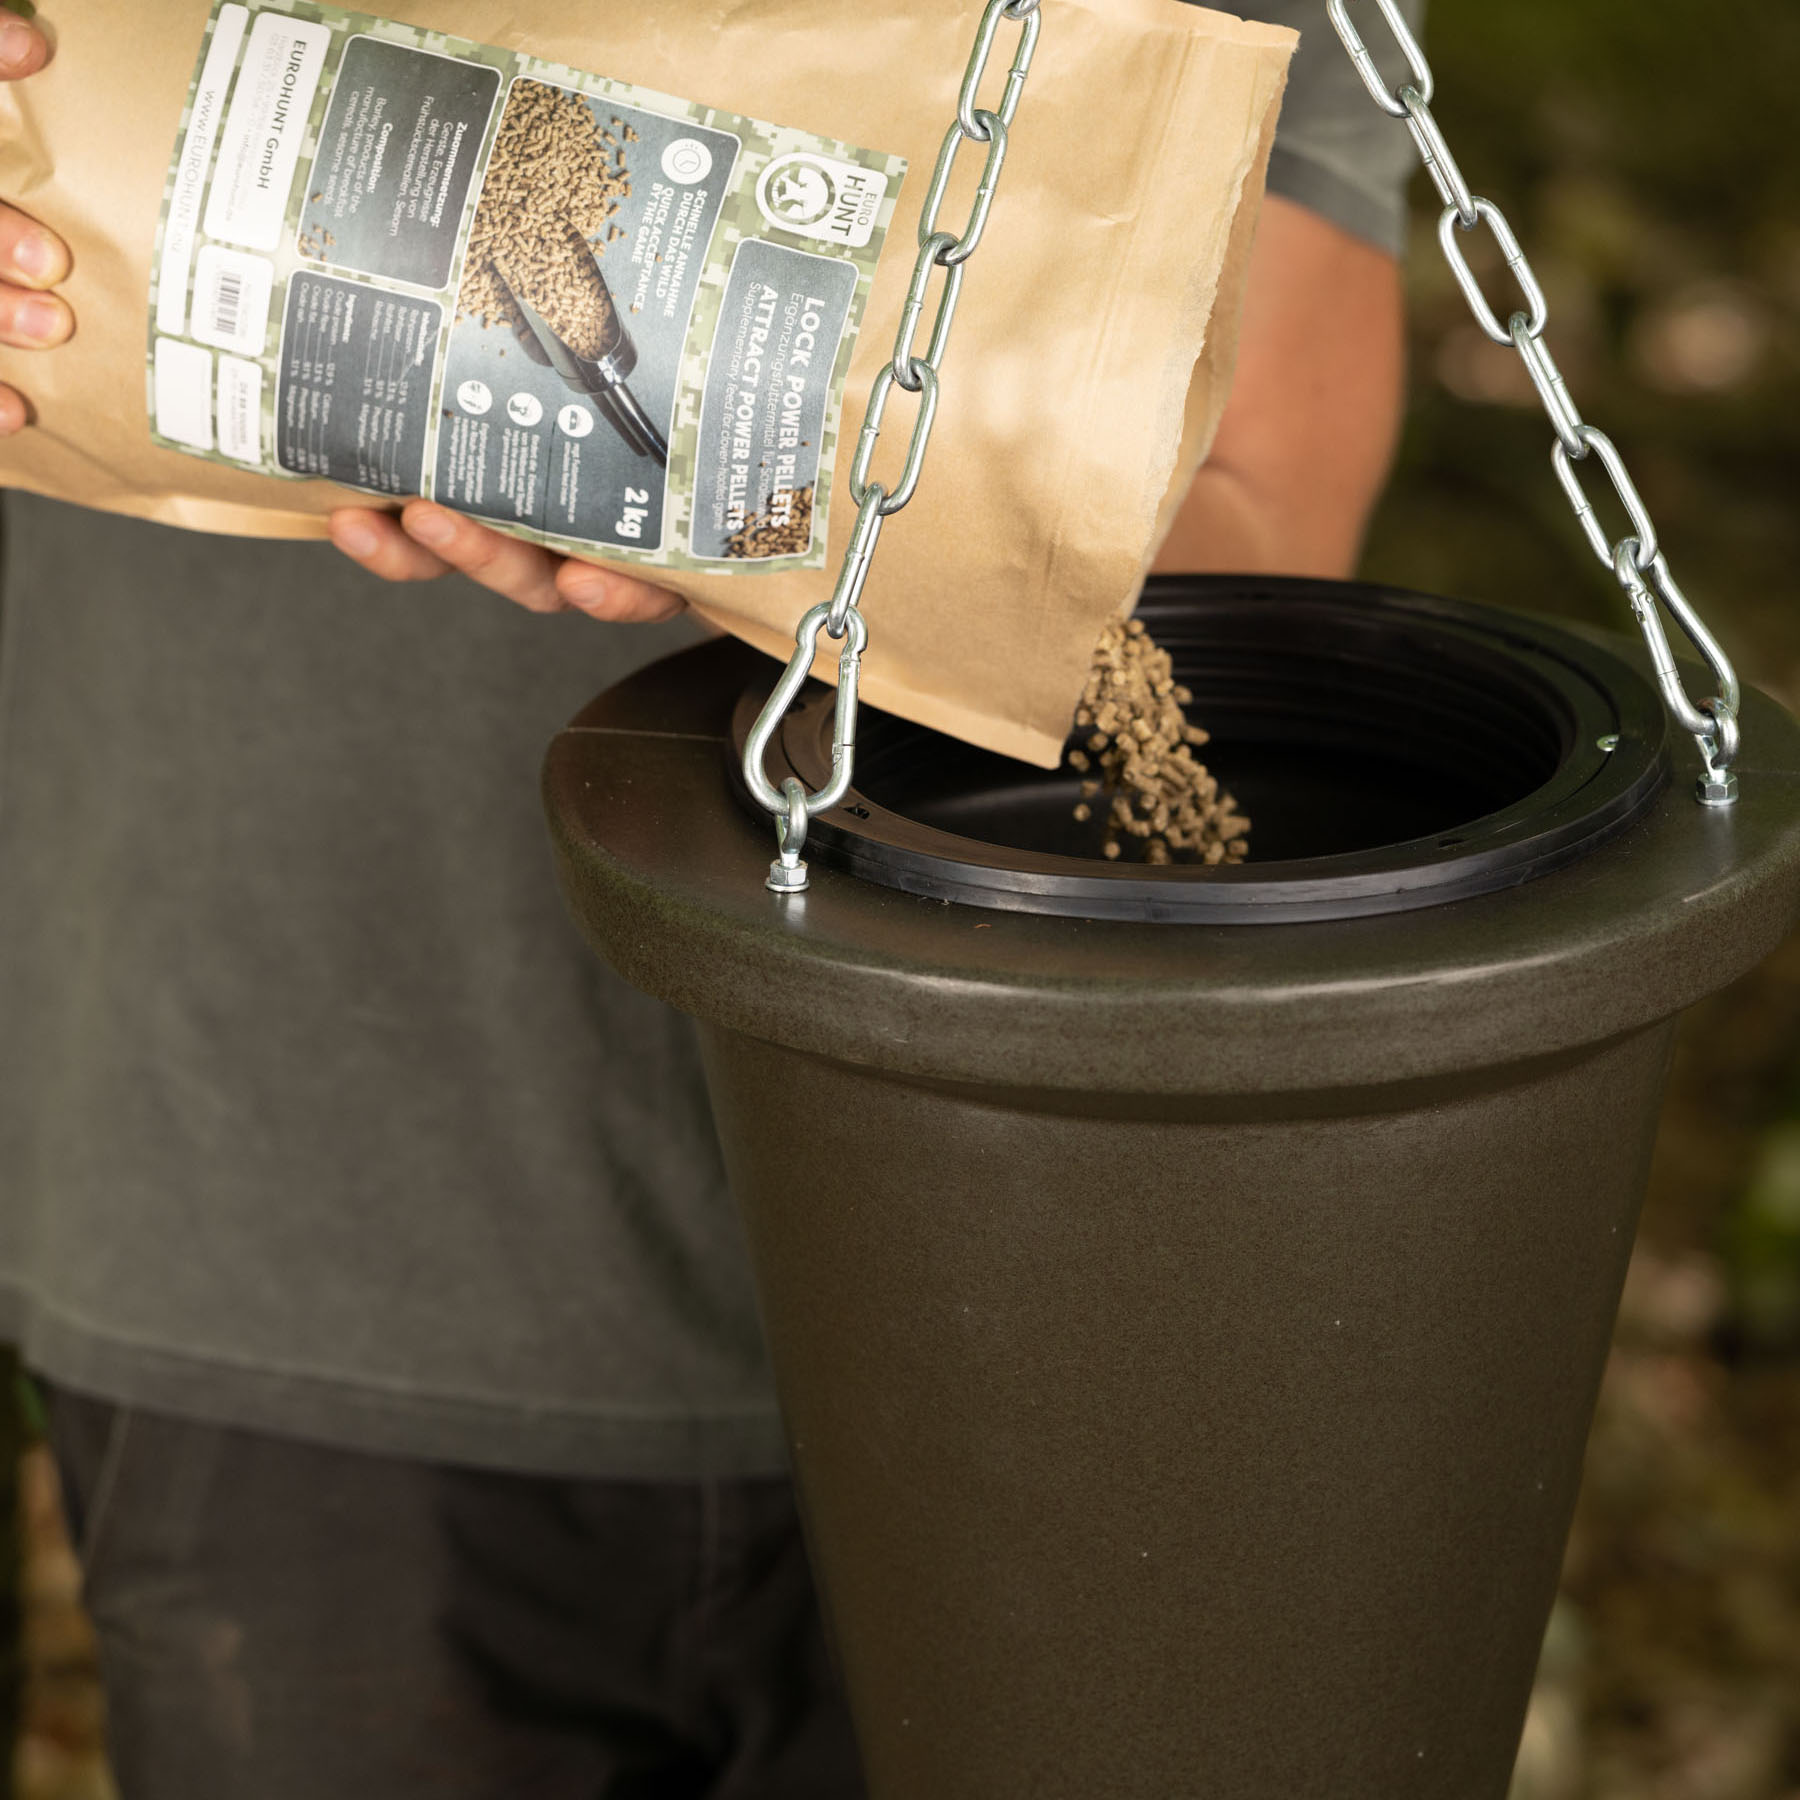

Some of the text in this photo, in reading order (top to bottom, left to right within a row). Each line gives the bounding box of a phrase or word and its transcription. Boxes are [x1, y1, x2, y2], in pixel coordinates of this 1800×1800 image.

[269, 38, 307, 134] EUROHUNT
[256, 136, 280, 190] GmbH
[330, 130, 350, 172] sesame
[333, 84, 374, 218] manufacture of breakfast
[351, 181, 364, 195] of
[355, 132, 377, 181] products
[365, 121, 393, 194] Composition:
[405, 117, 441, 218] der Herstellung von
[417, 120, 454, 223] Gerste, Erzeugnisse
[429, 120, 468, 228] Zusammensetzung:
[347, 194, 361, 214] the
[388, 199, 406, 237] Sesam
[630, 181, 663, 264] BY THE GAME
[830, 174, 866, 236] HUNT
[856, 191, 877, 226] EURO
[632, 185, 674, 310] QUICK ACCEPTANCE
[654, 191, 693, 299] DURCH DAS WILD
[662, 188, 708, 318] SCHNELLE ANNAHME
[724, 280, 761, 380] Supplementary
[721, 411, 734, 429] for
[722, 382, 738, 410] feed
[725, 284, 779, 532] ATTRACT POWER PELLETS
[769, 296, 825, 530] LOCK POWER PELLETS
[613, 484, 649, 540] 2 kg
